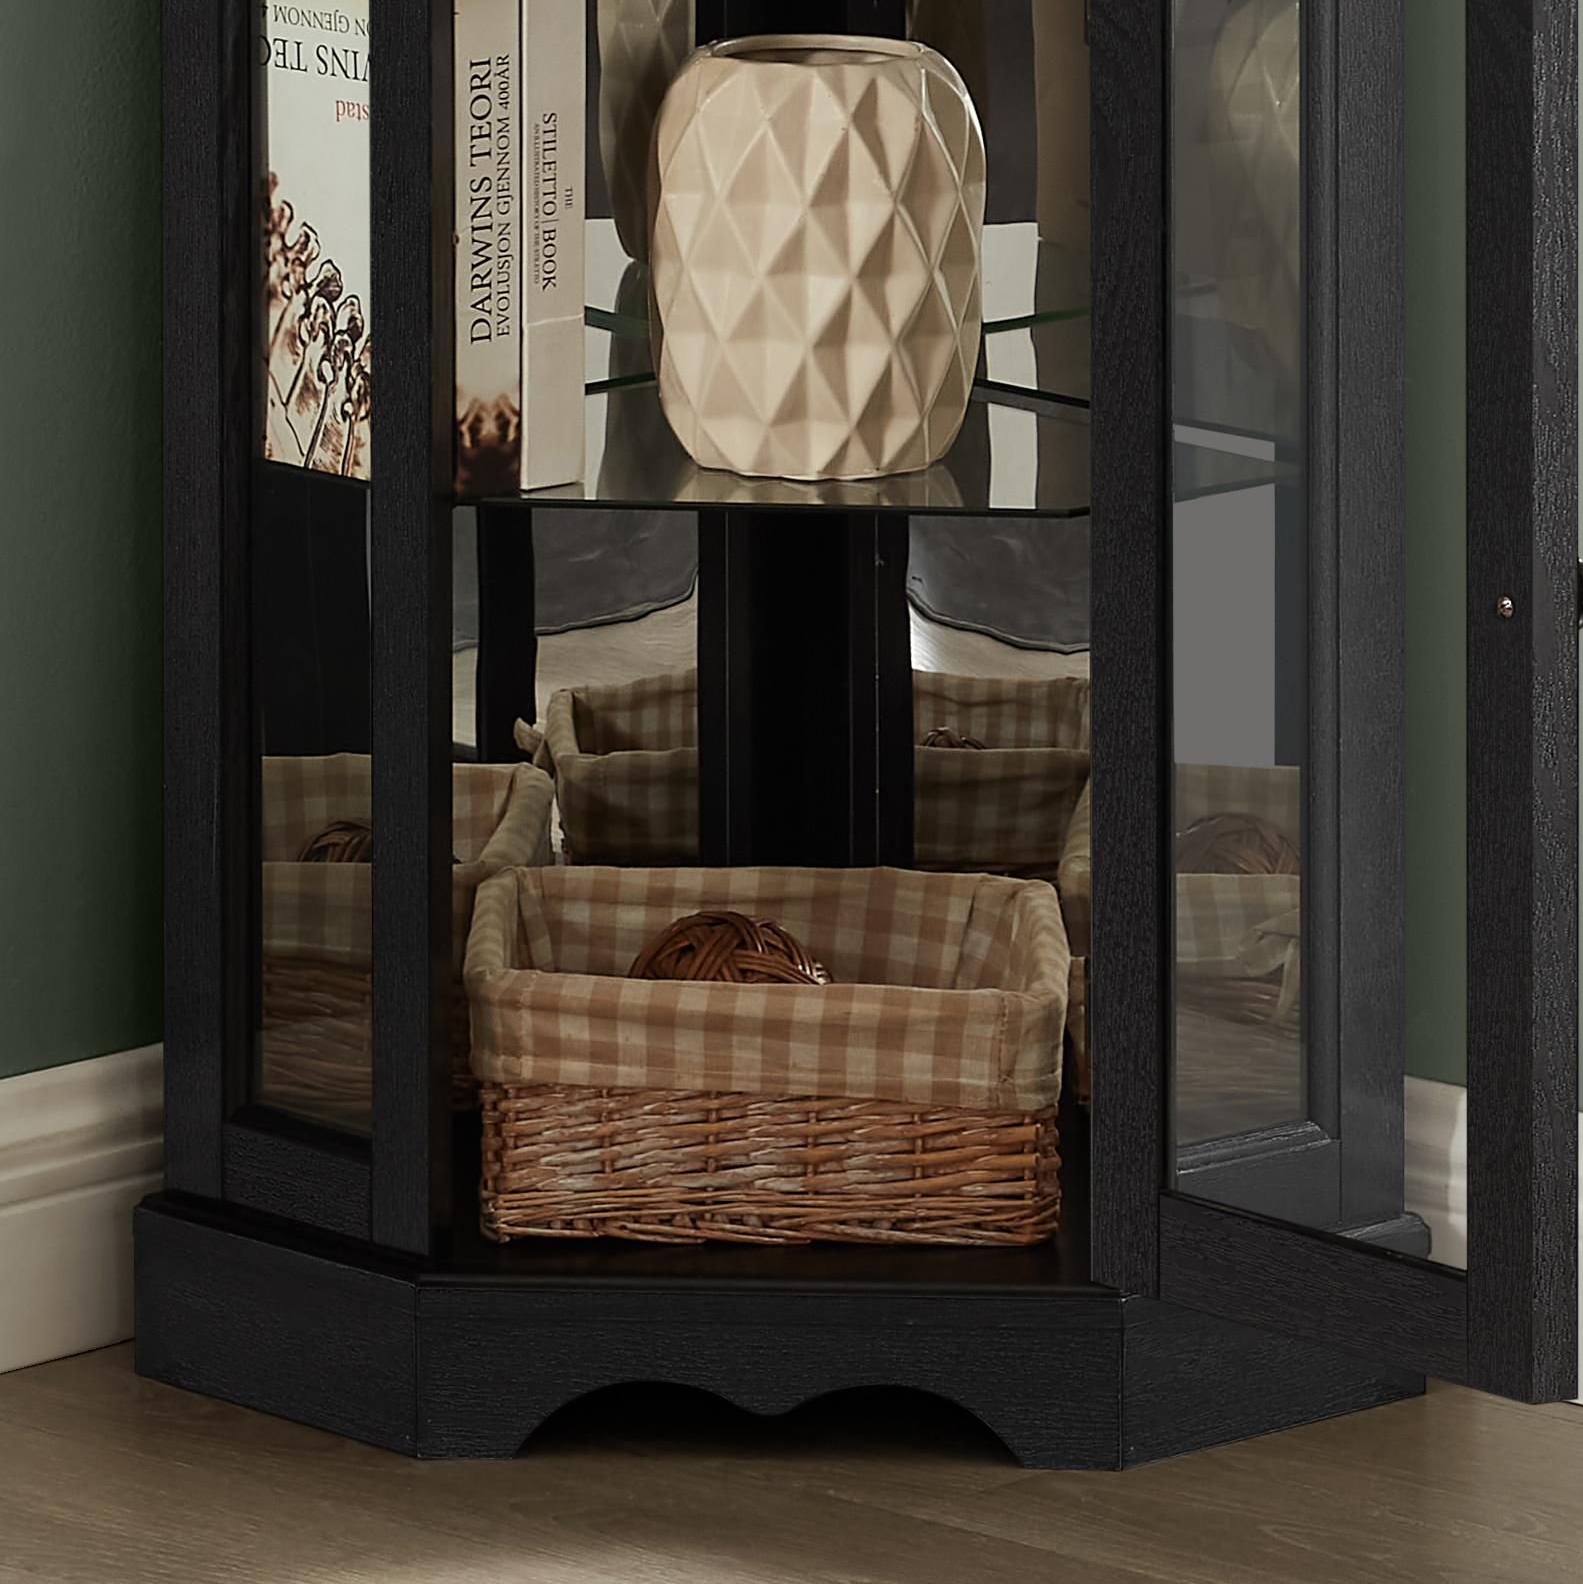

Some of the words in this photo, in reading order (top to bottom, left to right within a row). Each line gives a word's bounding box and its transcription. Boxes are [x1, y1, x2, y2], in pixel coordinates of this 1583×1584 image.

[274, 4, 350, 34] GJENNOM
[469, 56, 492, 168] TEORI
[542, 112, 557, 216] STILETTO
[497, 116, 514, 216] GJENNOM
[470, 176, 493, 345] DARWINS
[497, 222, 514, 337] EVOLUSJON
[542, 229, 557, 292] BOOK
